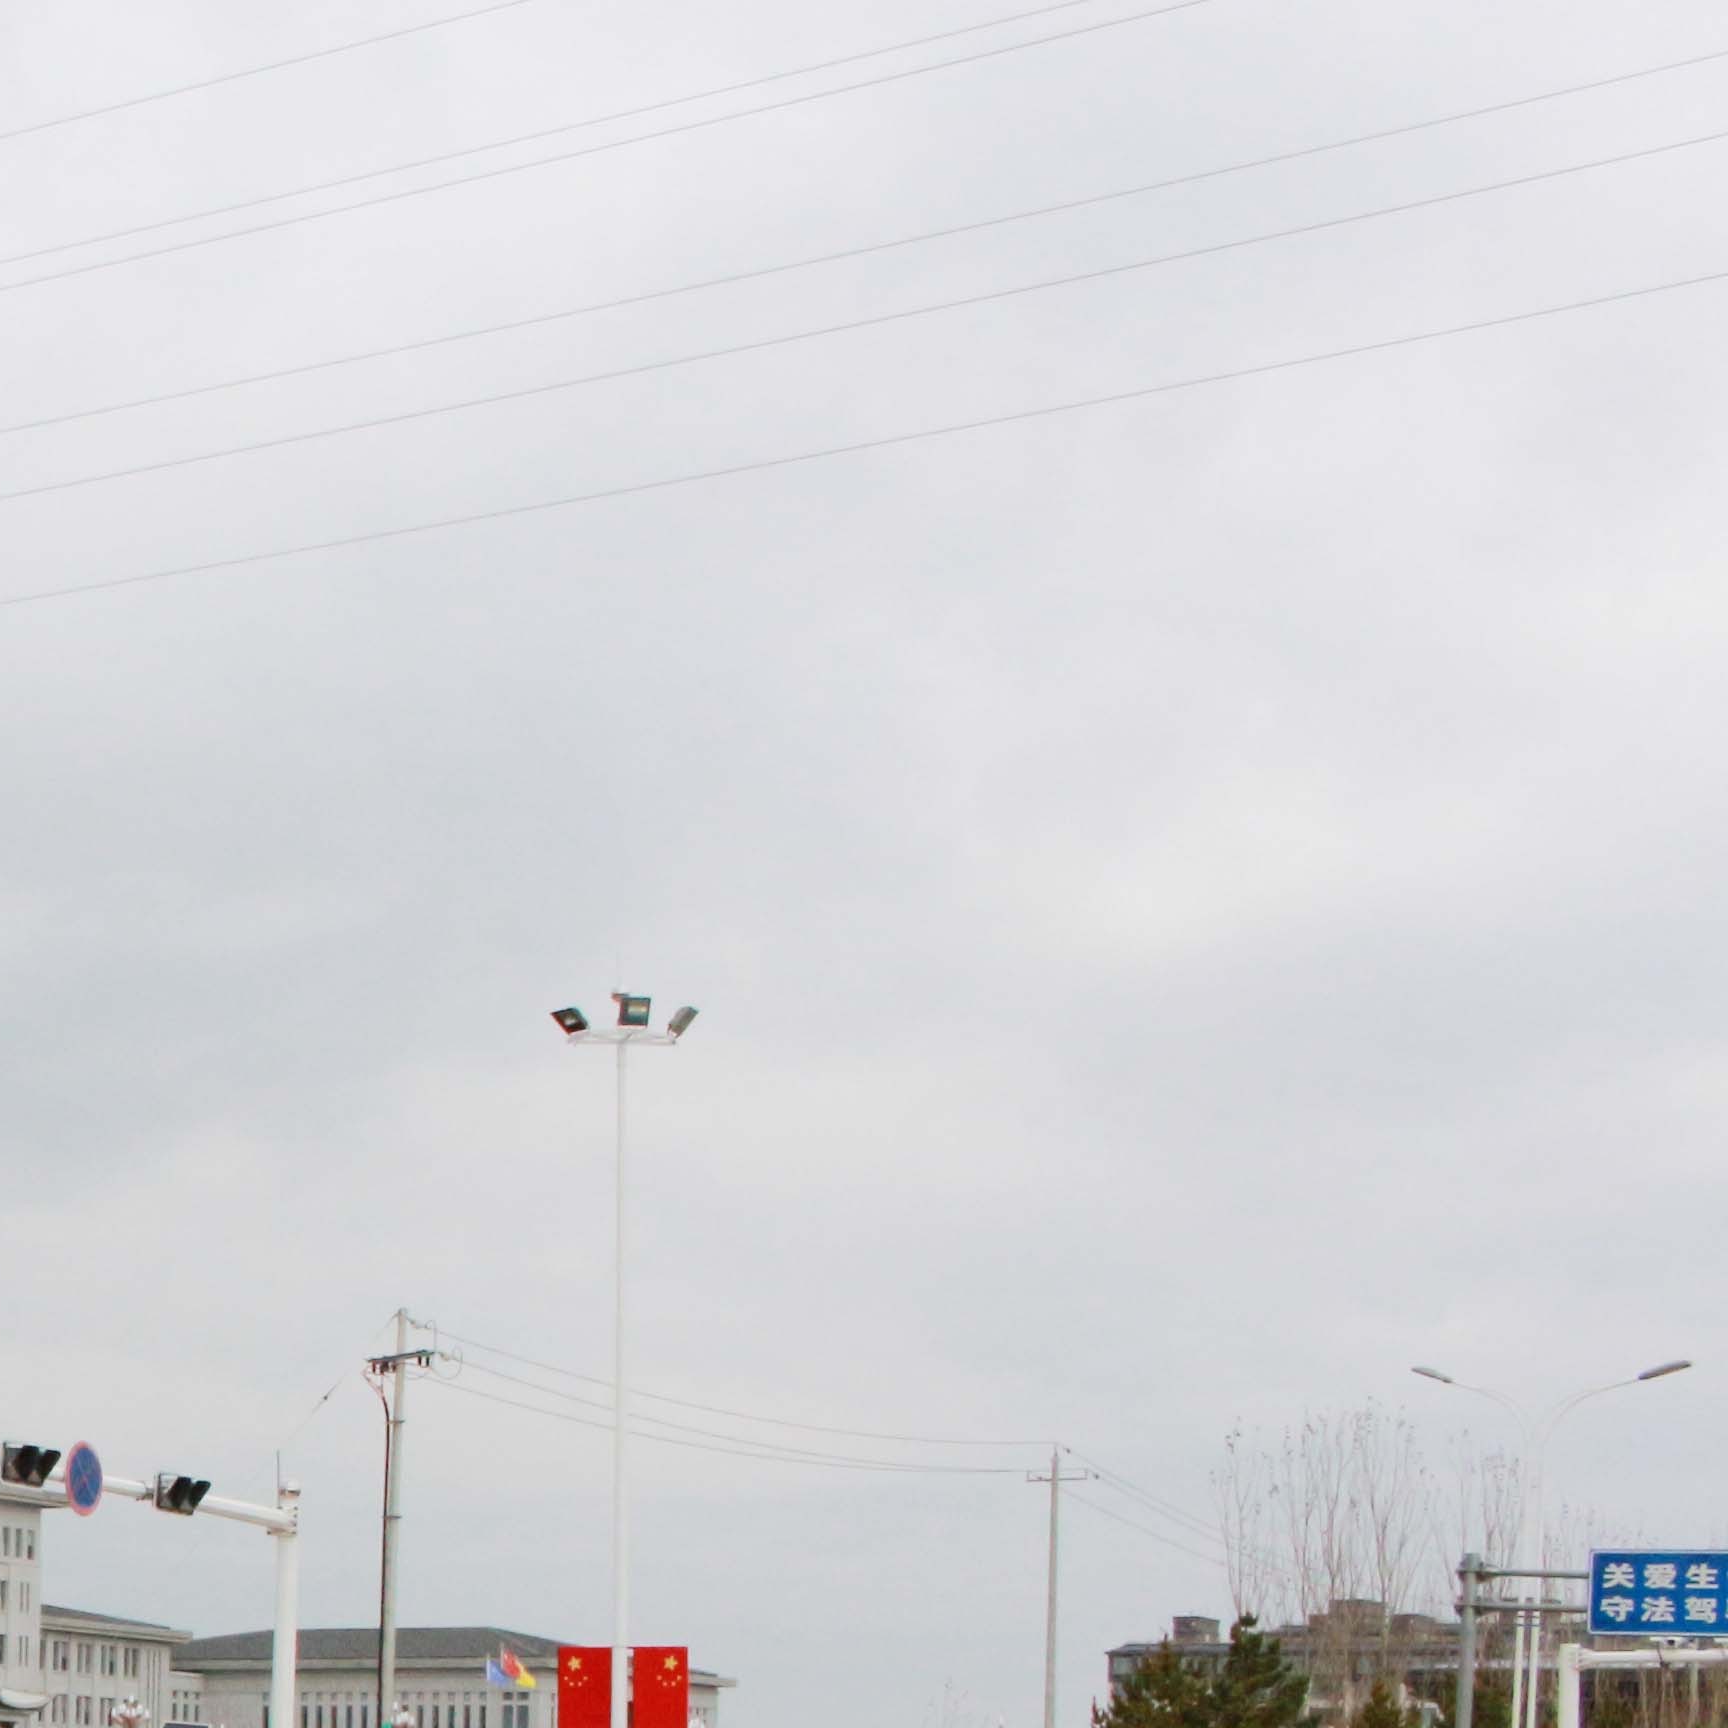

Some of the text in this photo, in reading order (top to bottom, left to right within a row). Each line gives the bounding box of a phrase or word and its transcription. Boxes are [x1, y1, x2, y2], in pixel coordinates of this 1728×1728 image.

[1602, 1562, 1728, 1590] 关爱生
[1600, 1595, 1728, 1624] 守法驾
